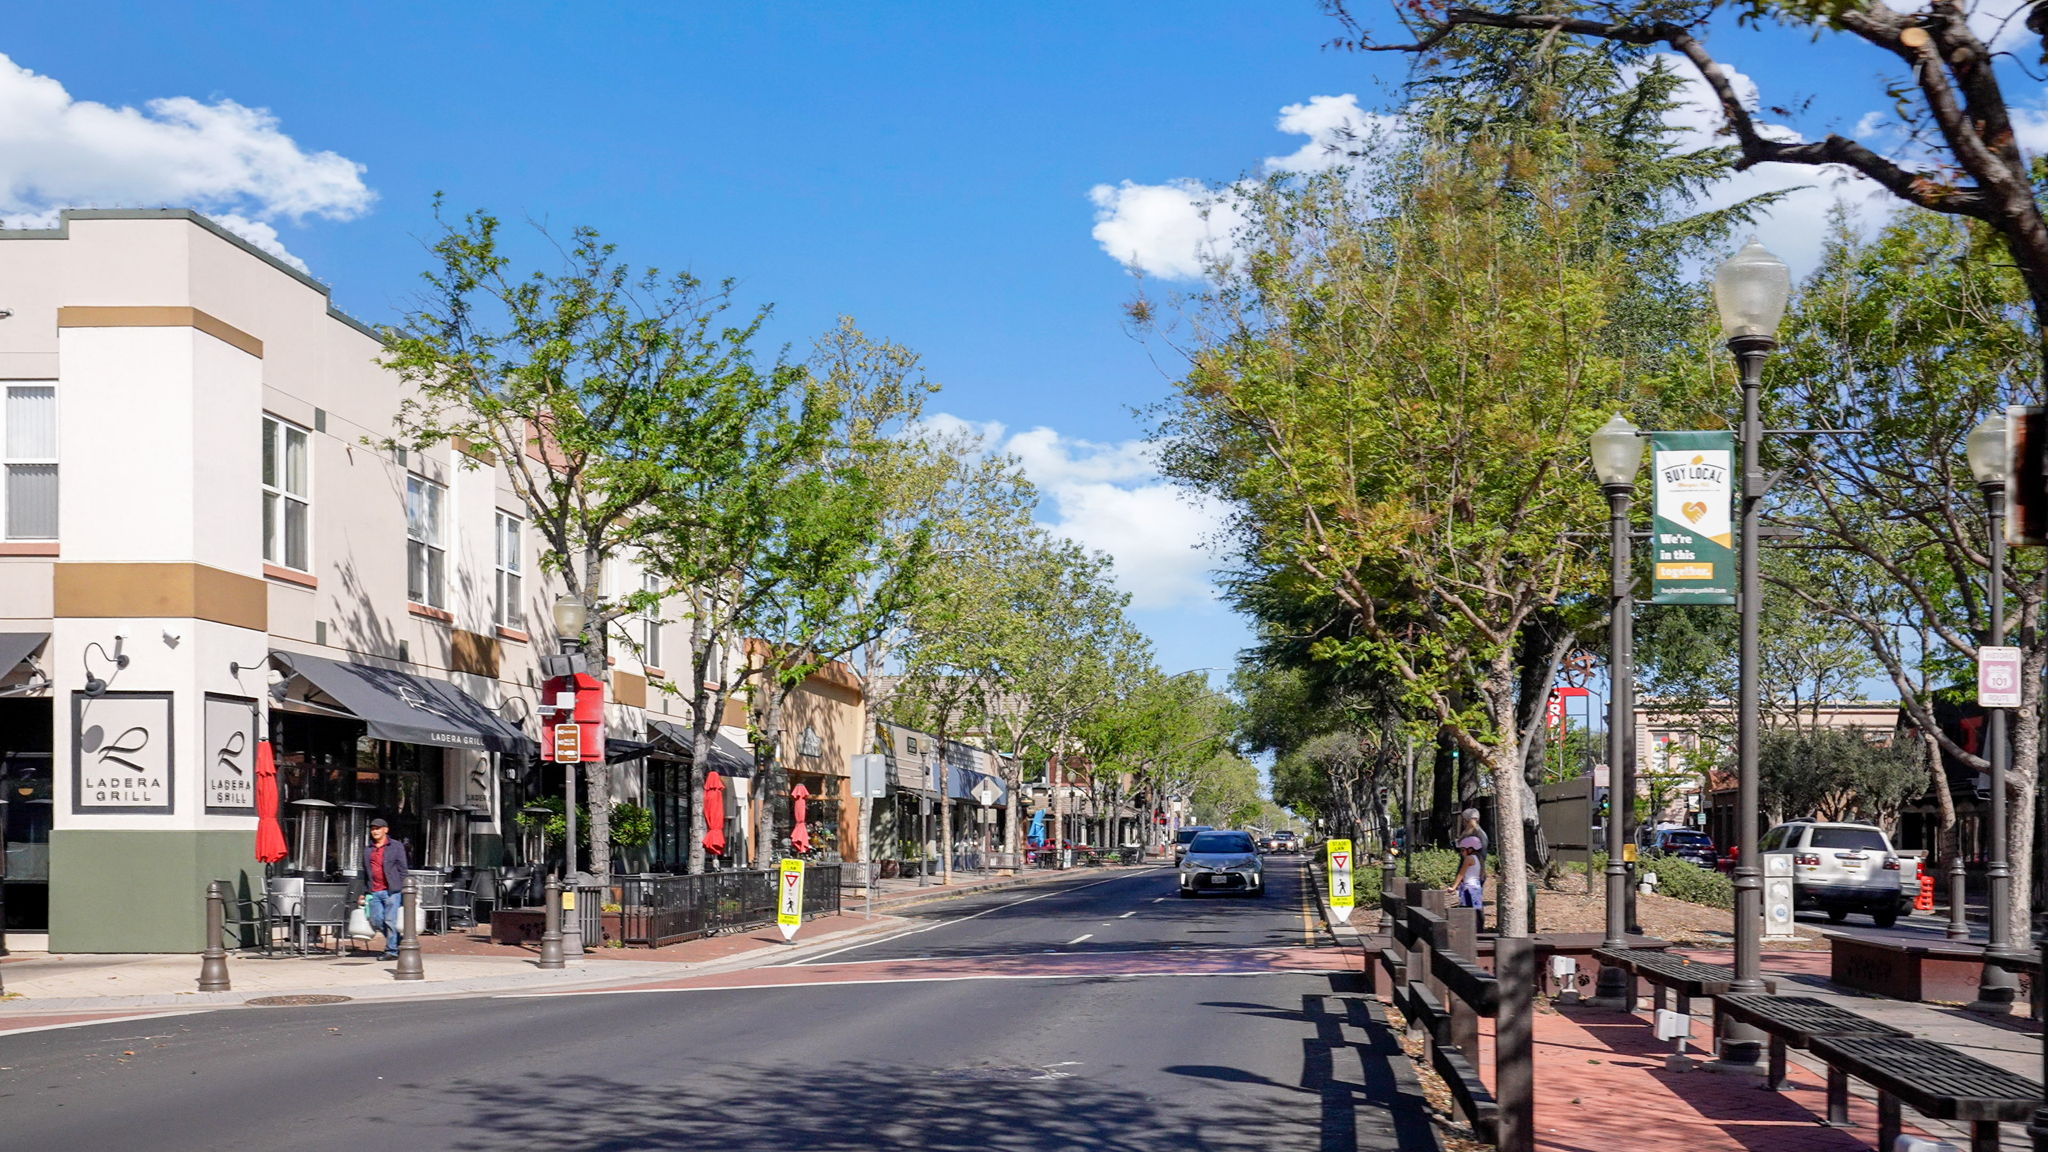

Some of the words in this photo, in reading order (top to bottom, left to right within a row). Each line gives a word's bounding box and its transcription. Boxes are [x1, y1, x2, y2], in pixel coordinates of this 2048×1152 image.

[1665, 468, 1686, 483] BUY
[1689, 467, 1722, 484] LOCAL
[1660, 533, 1692, 544] We're
[1660, 549, 1672, 560] in
[1673, 549, 1695, 560] this
[1661, 566, 1712, 578] together.
[1991, 677, 2008, 686] 101
[431, 732, 462, 744] LADERA
[463, 734, 485, 746] GRILL
[86, 778, 161, 789] LADERA
[211, 779, 251, 790] LADERA
[96, 791, 152, 802] GRILL
[217, 792, 247, 804] GRILL
